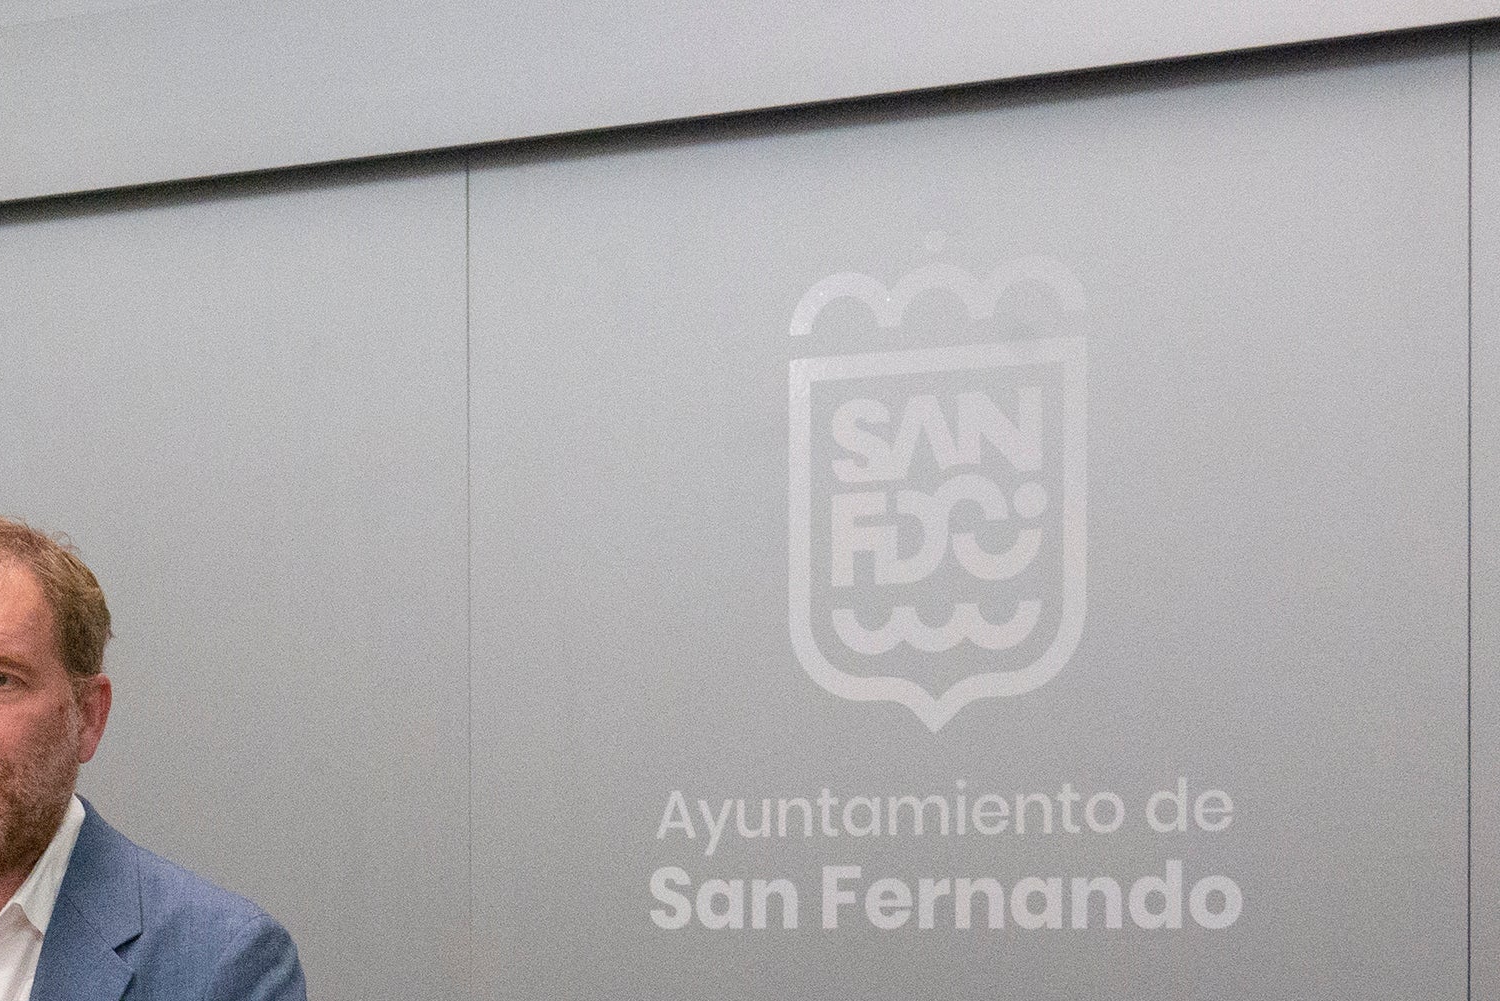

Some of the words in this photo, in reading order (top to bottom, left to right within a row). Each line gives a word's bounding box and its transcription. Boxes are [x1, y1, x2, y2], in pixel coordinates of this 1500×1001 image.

[831, 386, 1044, 484] SAN
[656, 778, 1126, 857] Ayuntamiento
[1145, 776, 1235, 834] de
[648, 865, 799, 931] San
[821, 859, 1244, 931] Fernando
